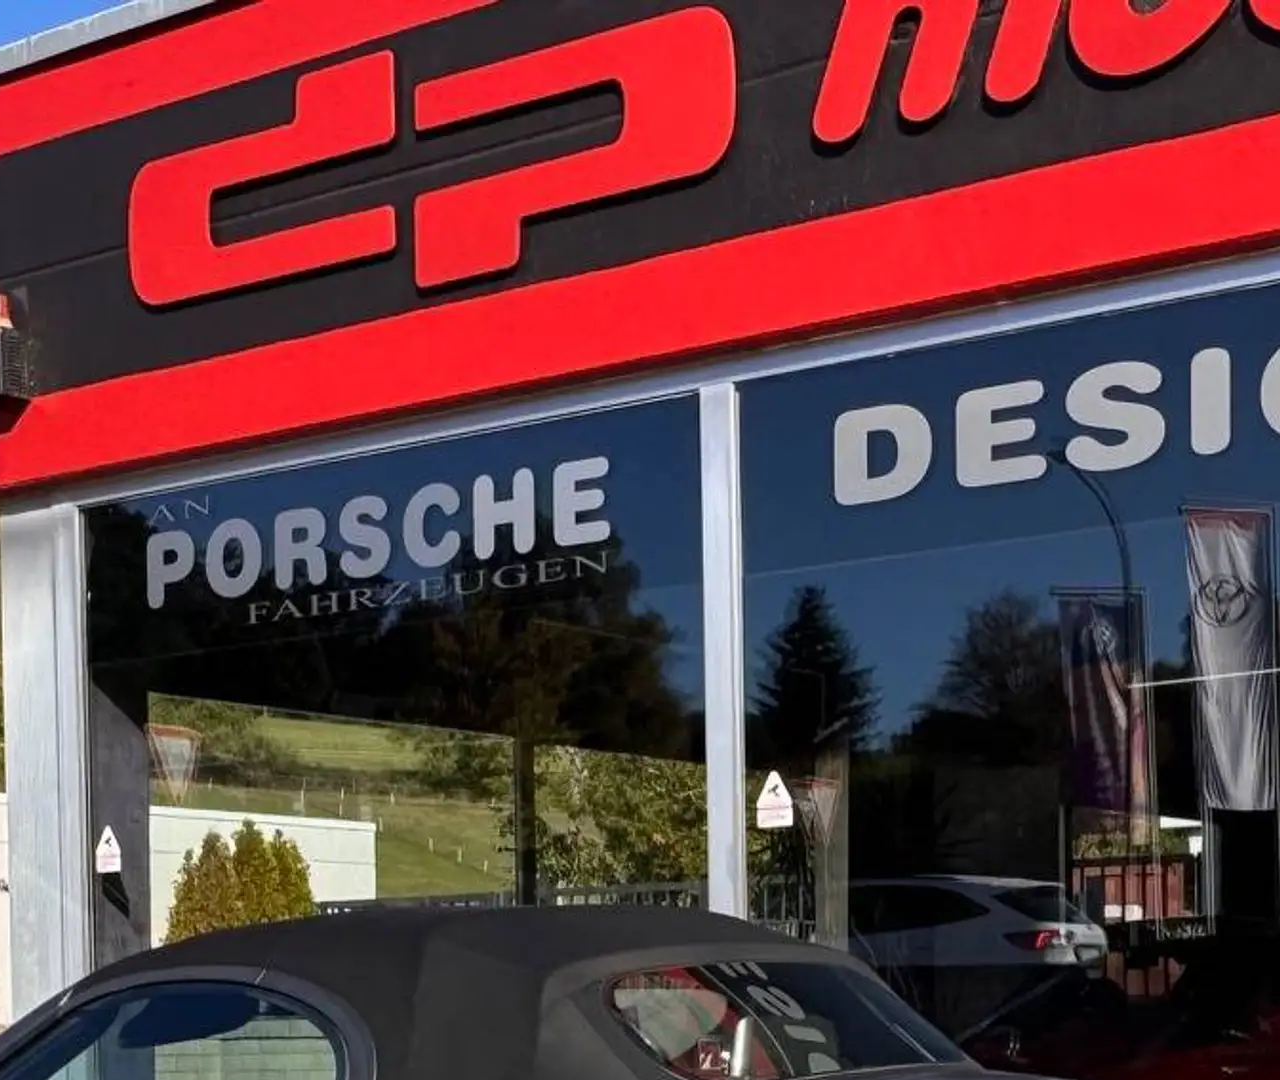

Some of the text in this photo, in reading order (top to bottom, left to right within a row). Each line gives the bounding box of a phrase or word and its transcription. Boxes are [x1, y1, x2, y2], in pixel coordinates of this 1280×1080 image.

[146, 456, 611, 609] PORSCHE
[151, 495, 211, 526] AN
[248, 551, 612, 625] FAHRZEUGEN
